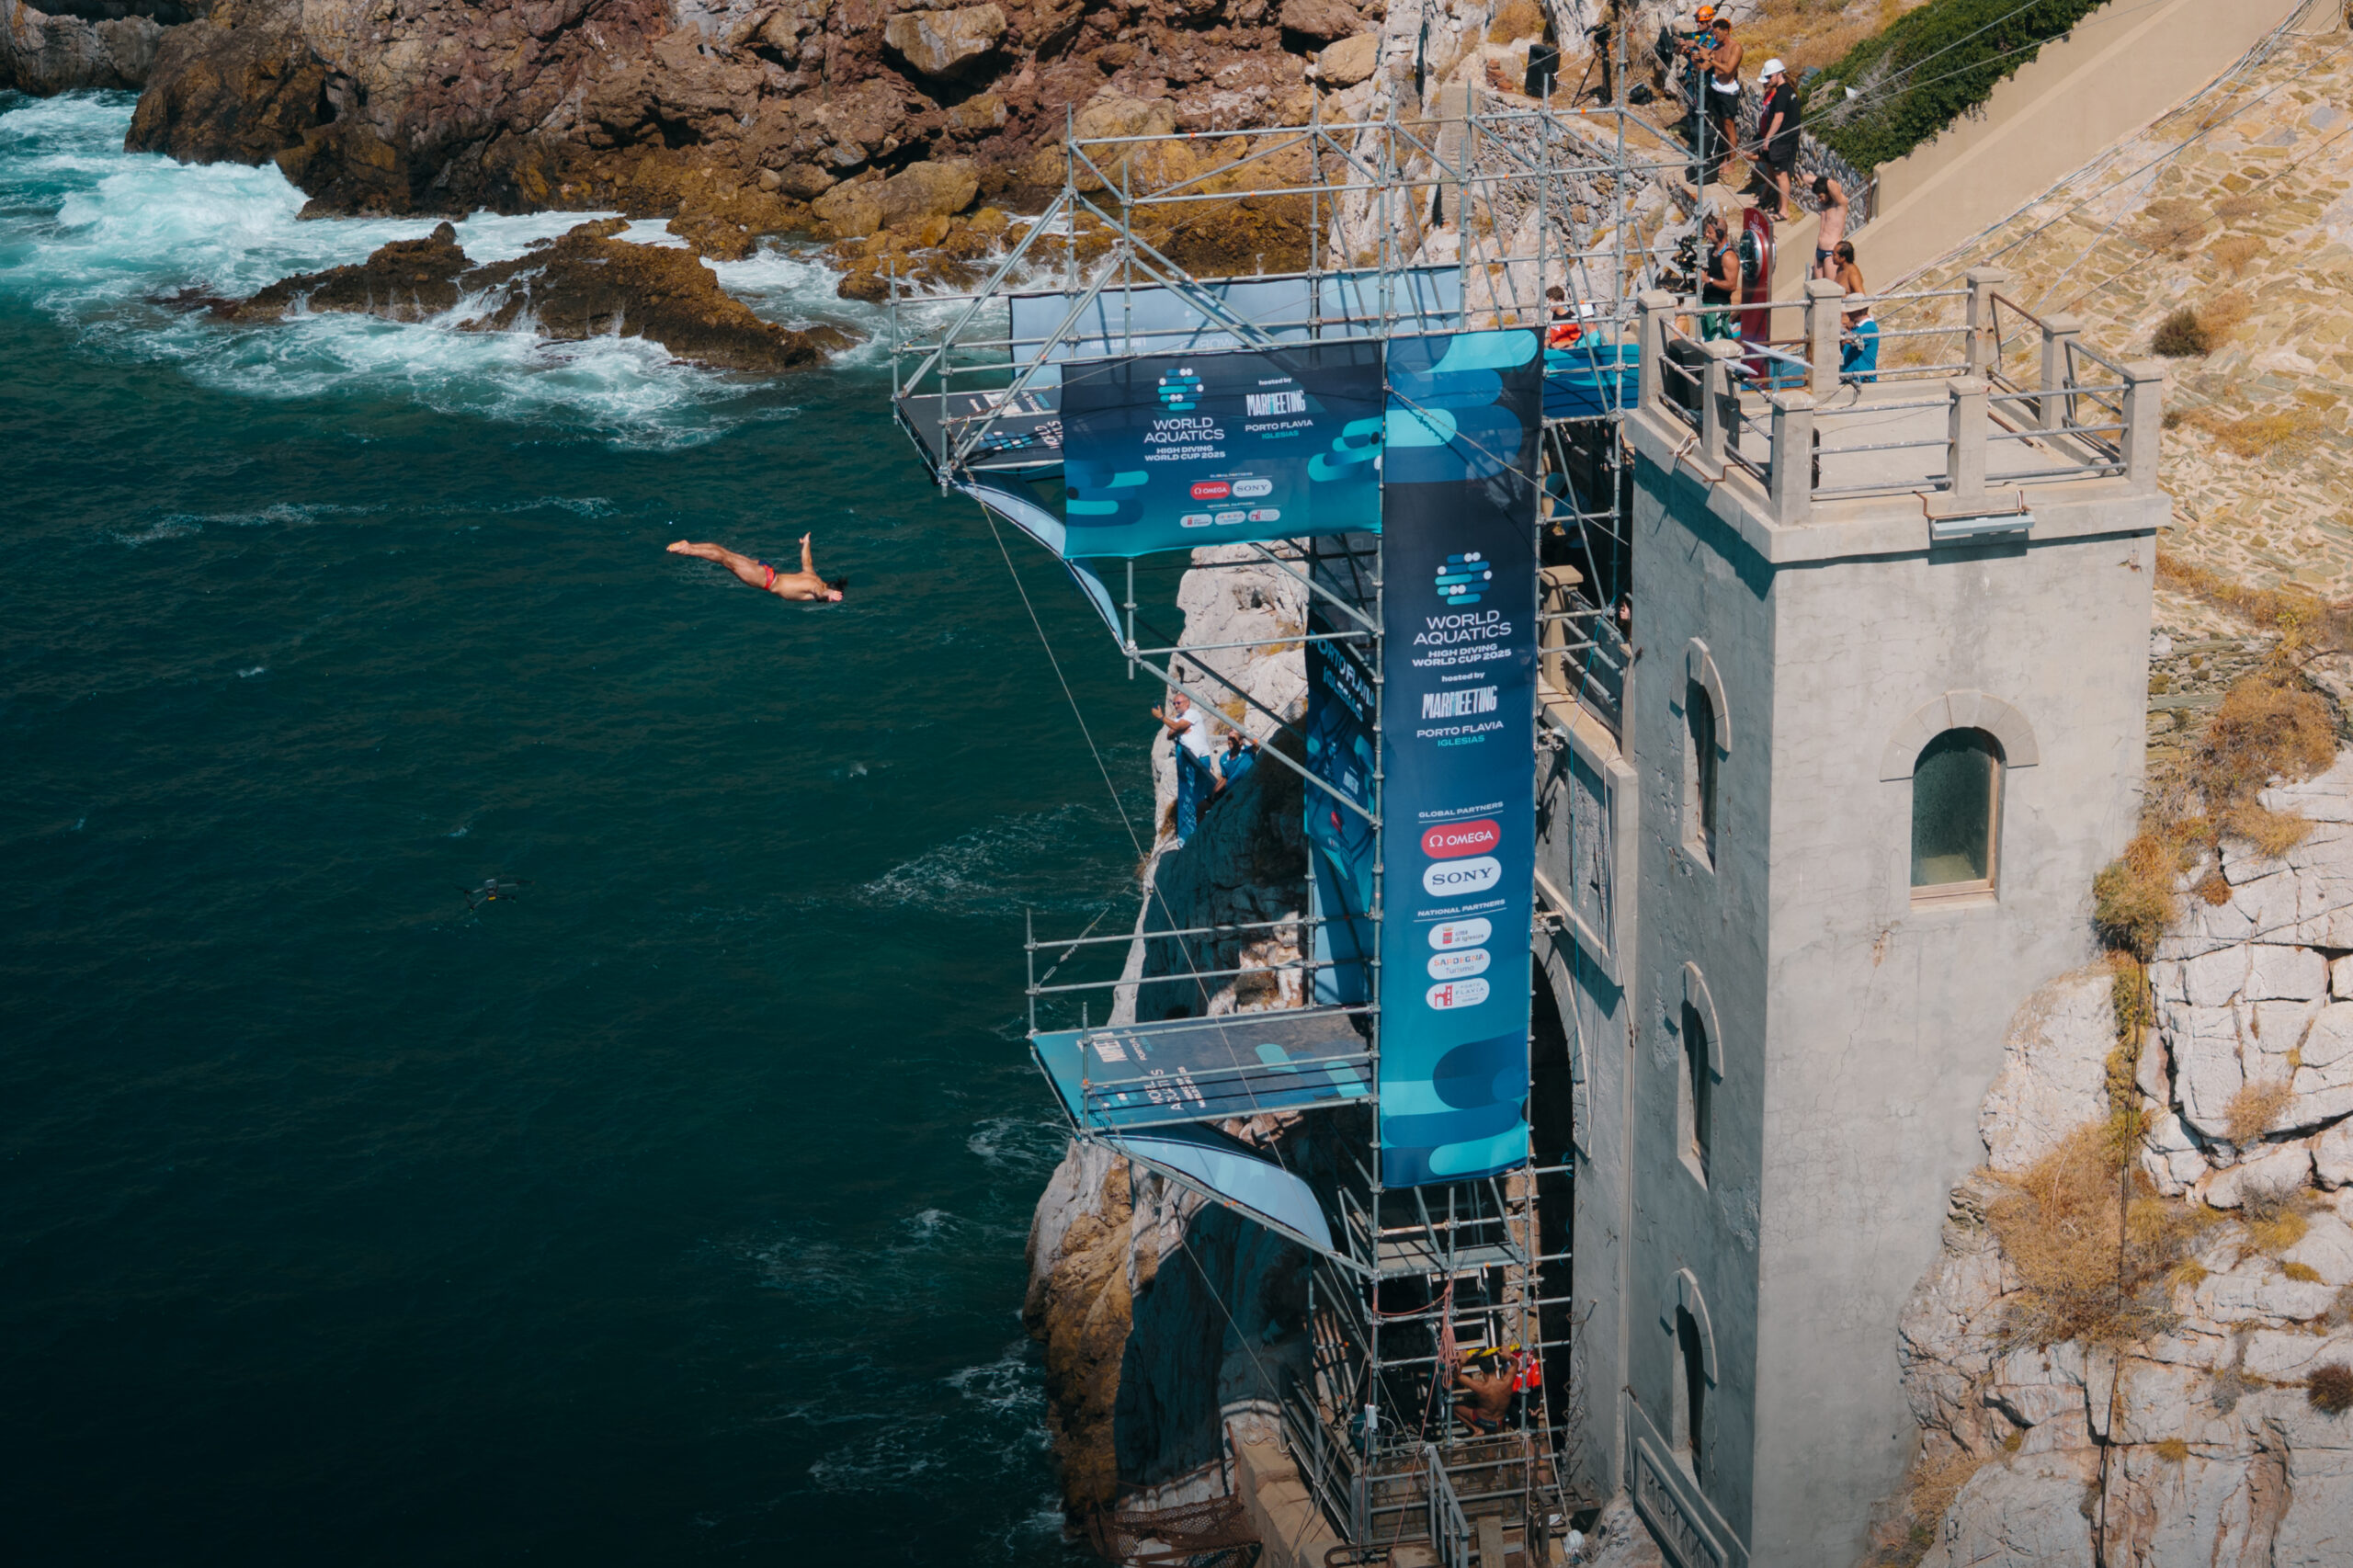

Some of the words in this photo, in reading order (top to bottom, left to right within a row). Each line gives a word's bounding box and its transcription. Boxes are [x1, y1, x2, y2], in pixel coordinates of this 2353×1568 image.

[1258, 378, 1283, 386] hosted
[1283, 377, 1292, 385] by
[1153, 416, 1214, 431] WORLD
[1245, 423, 1279, 432] PORTO
[1280, 419, 1313, 429] FLAVIA
[1143, 429, 1225, 444] AQUATICS
[1261, 430, 1300, 439] IGLESIAS
[1144, 453, 1179, 461] WORLD
[1201, 450, 1226, 459] 2025
[1156, 446, 1181, 454] HIGH
[1181, 445, 1214, 453] DIVING
[1202, 486, 1228, 494] OMEGA
[1427, 609, 1500, 631] WORLD
[1413, 621, 1512, 646] AQUATICS
[1412, 657, 1456, 667] WORLD
[1458, 653, 1483, 664] CUP
[1483, 648, 1512, 661] 2025
[1428, 649, 1458, 658] HIGH
[1460, 643, 1498, 655] DIVING
[1441, 673, 1472, 683] hosted
[1473, 671, 1485, 679] by
[1422, 685, 1498, 720] MARMEETING
[1416, 726, 1460, 738] PORTO
[1461, 720, 1504, 733] FLAVIA
[1438, 735, 1485, 747] IGLESIAS
[1418, 810, 1455, 818] GLOBAL
[1457, 801, 1504, 814] PARTNERS
[1446, 830, 1494, 846] OMEGA
[1432, 867, 1493, 886] SONY
[1417, 906, 1461, 917] NATIONAL
[1461, 899, 1506, 912] PARTNERS
